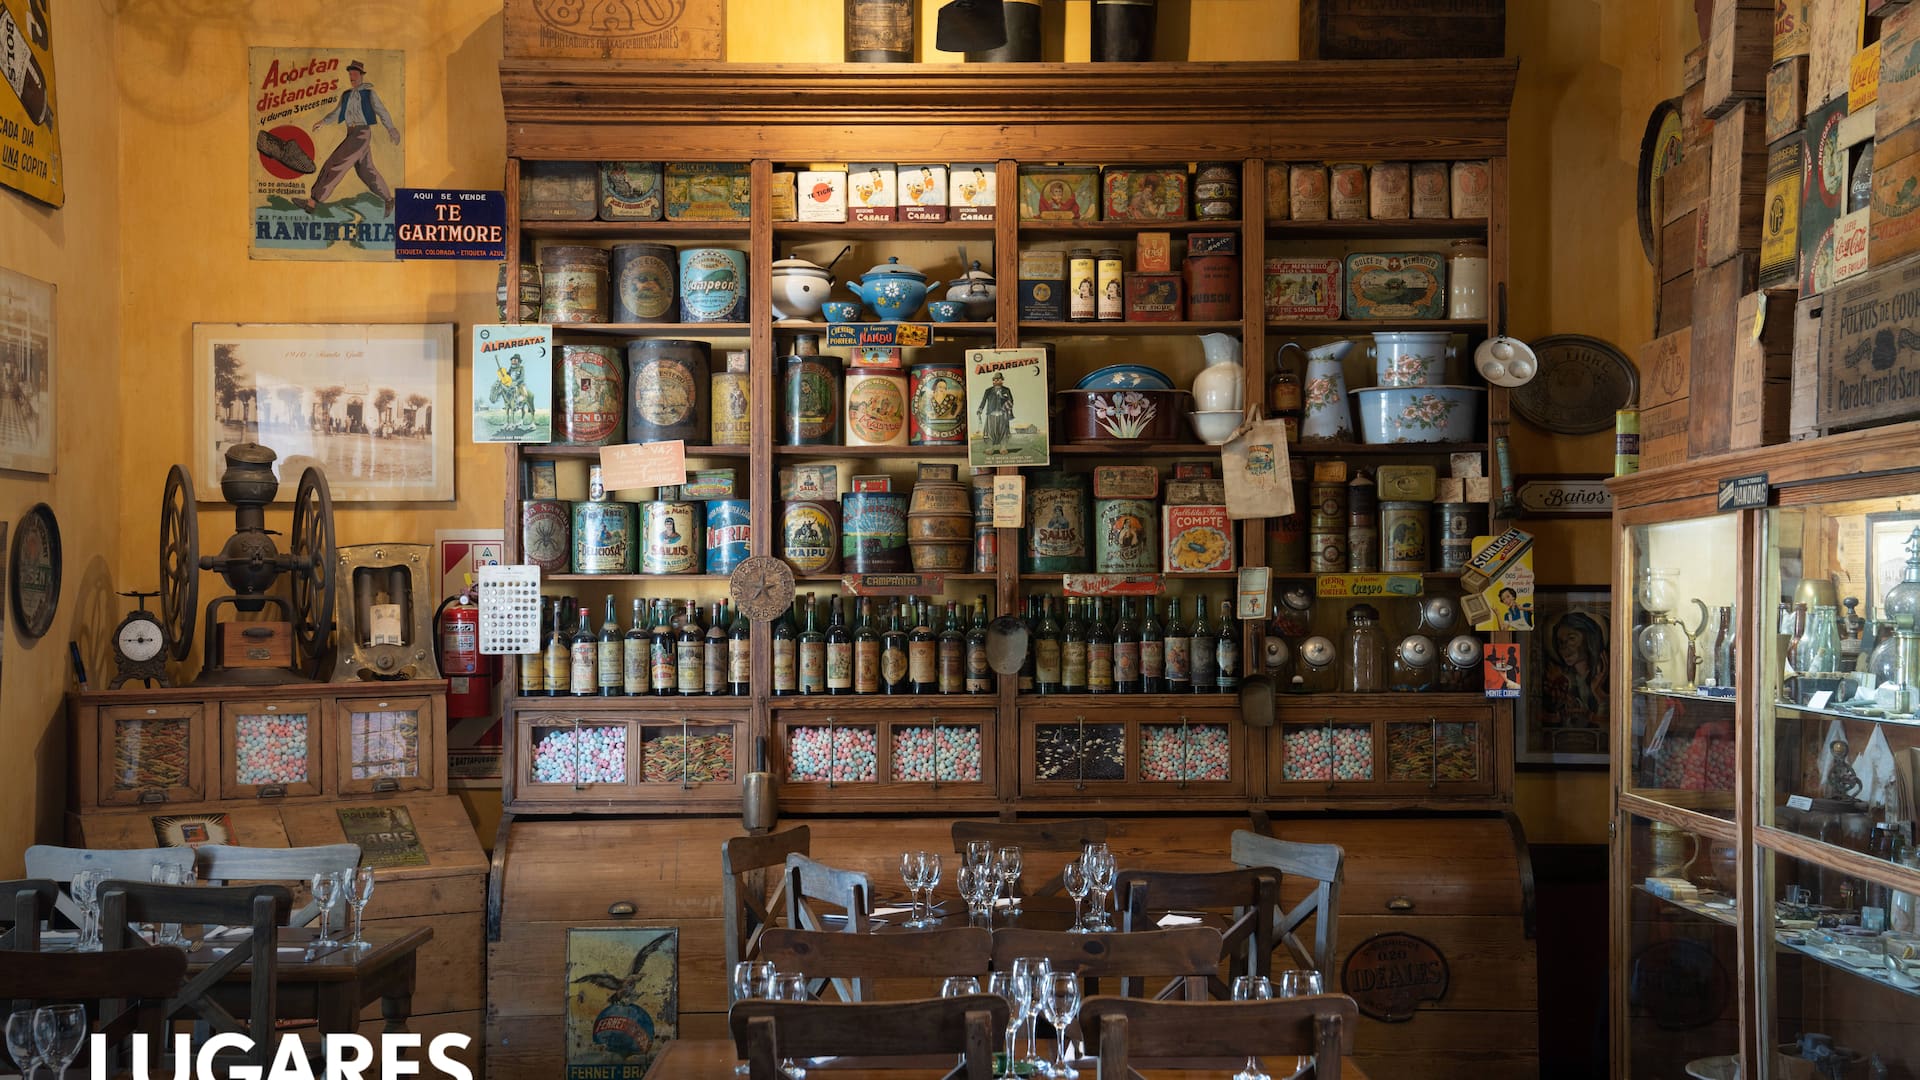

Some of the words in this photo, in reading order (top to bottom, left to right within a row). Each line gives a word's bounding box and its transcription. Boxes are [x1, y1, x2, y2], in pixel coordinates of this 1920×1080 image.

[6, 18, 16, 82] BOLS
[262, 57, 339, 90] Acortan
[256, 78, 339, 112] distancias
[267, 109, 292, 122] duran
[294, 104, 299, 113] 3
[300, 101, 319, 112] veces
[22, 129, 34, 148] DIA
[2, 145, 18, 167] UNA
[21, 153, 47, 179] COPITA
[816, 187, 835, 198] TIGRE
[435, 204, 462, 221] TE
[256, 222, 395, 242] RANCHERIA
[399, 224, 503, 242] GARTMORE
[1354, 256, 1374, 266] DULCE
[1840, 300, 1878, 338] POLVOS
[1880, 303, 1890, 322] DE
[481, 336, 546, 353] ALPARGATAS
[975, 358, 1039, 375] ALPARGATAS
[1839, 378, 1859, 410] Para
[1860, 373, 1888, 408] Curar
[1889, 370, 1897, 401] la
[1544, 487, 1606, 507] Baños
[1176, 516, 1224, 528] COMPTE
[1040, 528, 1076, 541] SALUS
[651, 544, 688, 556] SALUS
[788, 548, 826, 557] MAIPU
[1472, 527, 1522, 569] SUNLIGHT
[1352, 584, 1382, 595] CRESPO
[1351, 961, 1440, 993] IDEALES
